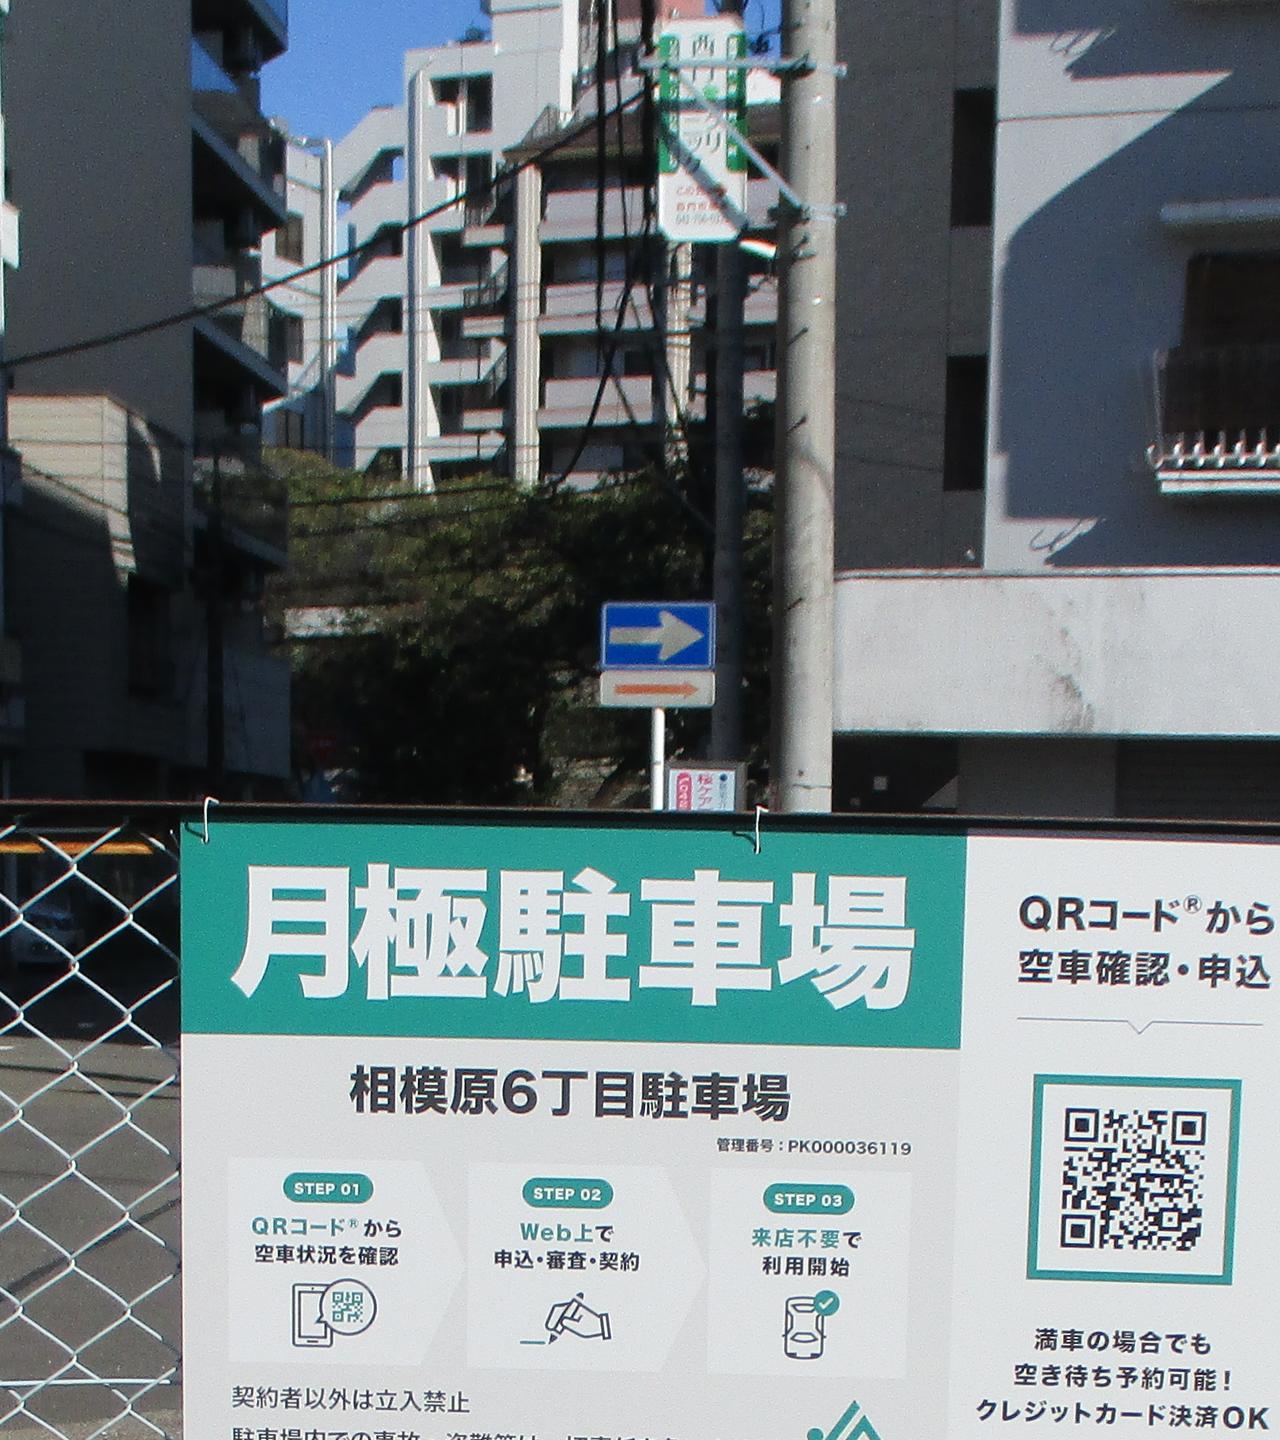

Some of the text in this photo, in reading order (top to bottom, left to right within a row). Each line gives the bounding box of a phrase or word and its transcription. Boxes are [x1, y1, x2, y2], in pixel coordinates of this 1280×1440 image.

[231, 862, 917, 1011] 月極駐車場
[1017, 948, 1271, 989] 空車確認・申込
[349, 1063, 792, 1123] 相模原6丁目駐車場
[293, 1182, 361, 1196] STEP 01
[532, 1186, 602, 1202] STEP 02
[773, 1192, 844, 1208] STEP 03
[520, 1222, 615, 1243] Web上で
[751, 1227, 863, 1250] 来店不要で
[254, 1244, 400, 1266] 空車状況を確認
[493, 1249, 640, 1273] 申込・審査・契約
[762, 1255, 851, 1278] 利用開始
[1033, 1327, 1212, 1355] 満車の場合でも
[231, 1385, 471, 1414] 契約者以外は立入禁止
